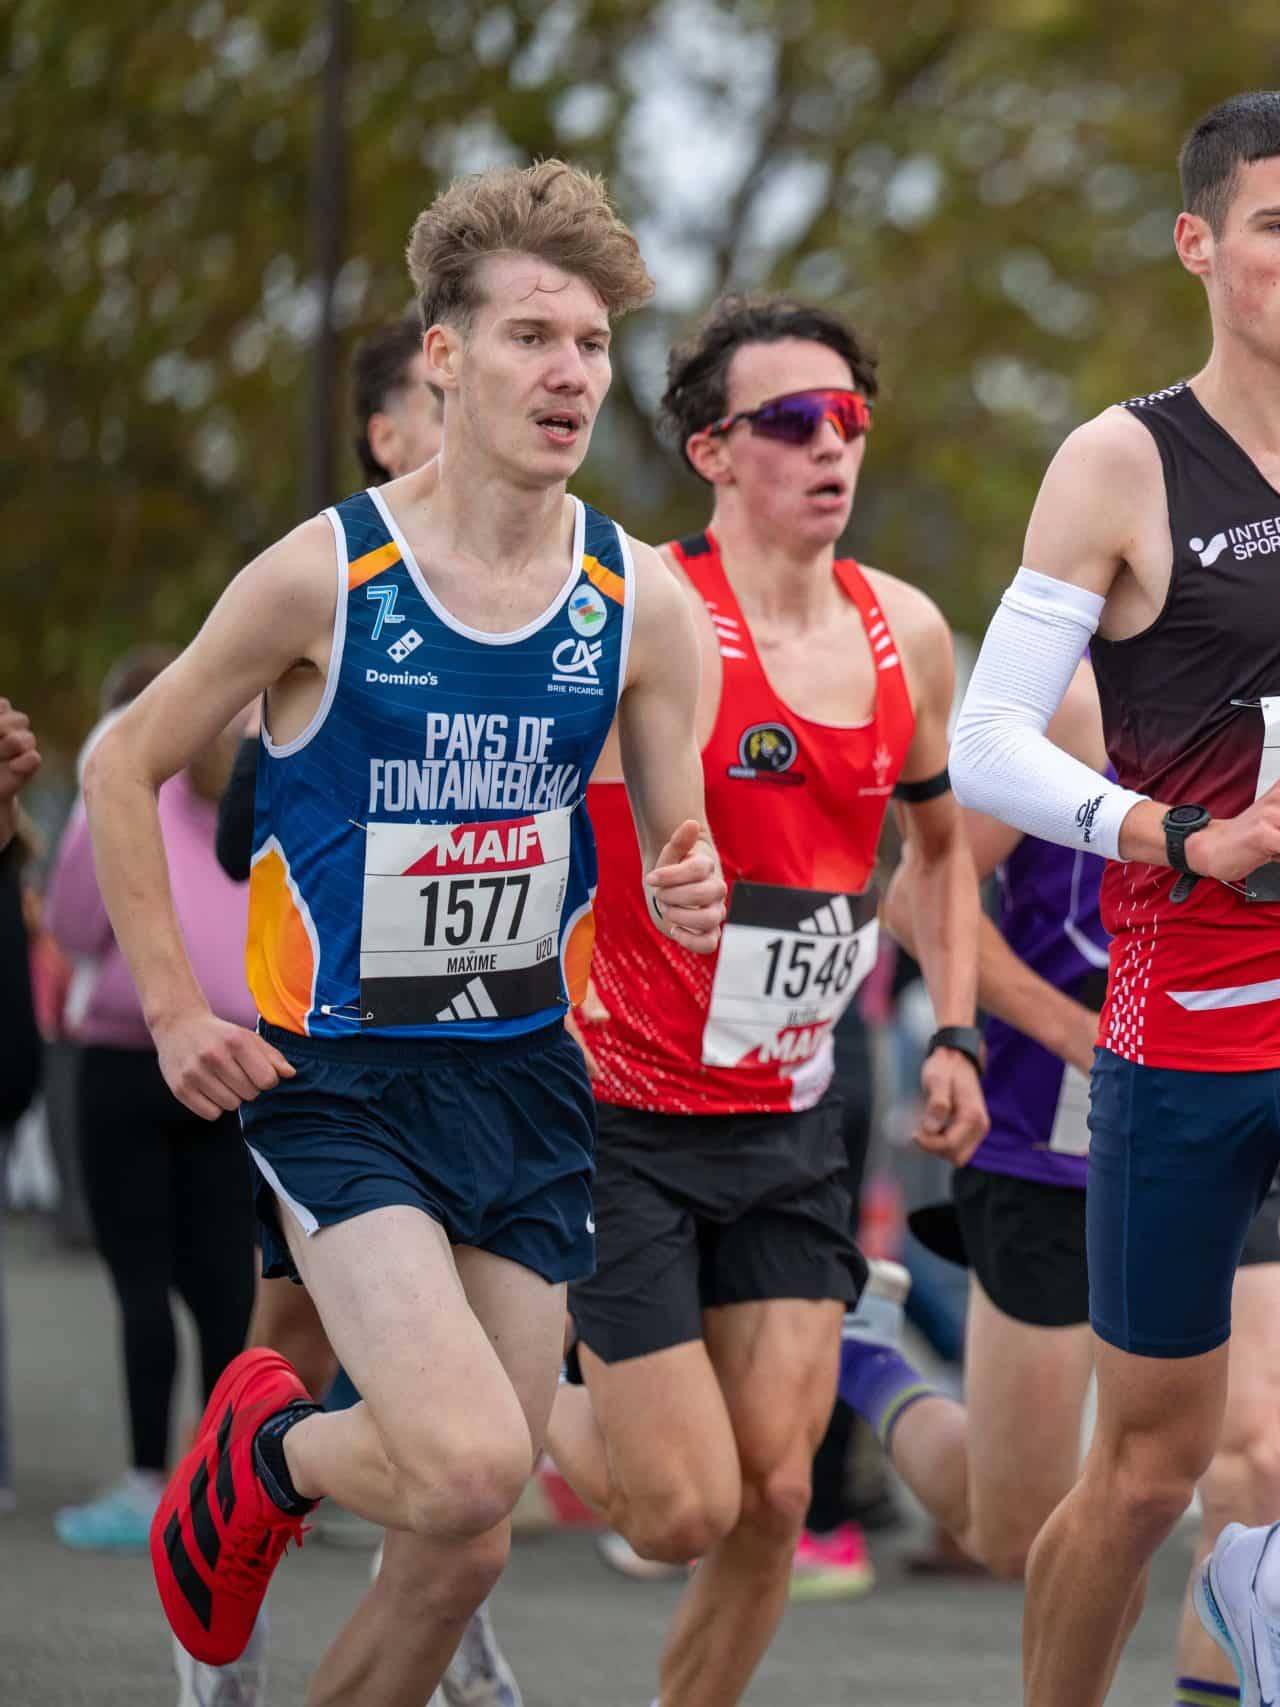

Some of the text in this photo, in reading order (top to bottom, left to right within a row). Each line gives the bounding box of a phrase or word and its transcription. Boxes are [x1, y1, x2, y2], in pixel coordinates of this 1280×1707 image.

[366, 669, 439, 686] Domino's
[547, 684, 604, 696] BRIE PICARDIE
[425, 712, 554, 763] PAYS DE
[369, 758, 581, 814] FONTAINEBLEAU
[436, 824, 540, 867] MAIF
[419, 873, 531, 946] 1577
[447, 954, 498, 973] MAXIME
[536, 937, 552, 961] U20
[764, 938, 859, 998] 1548
